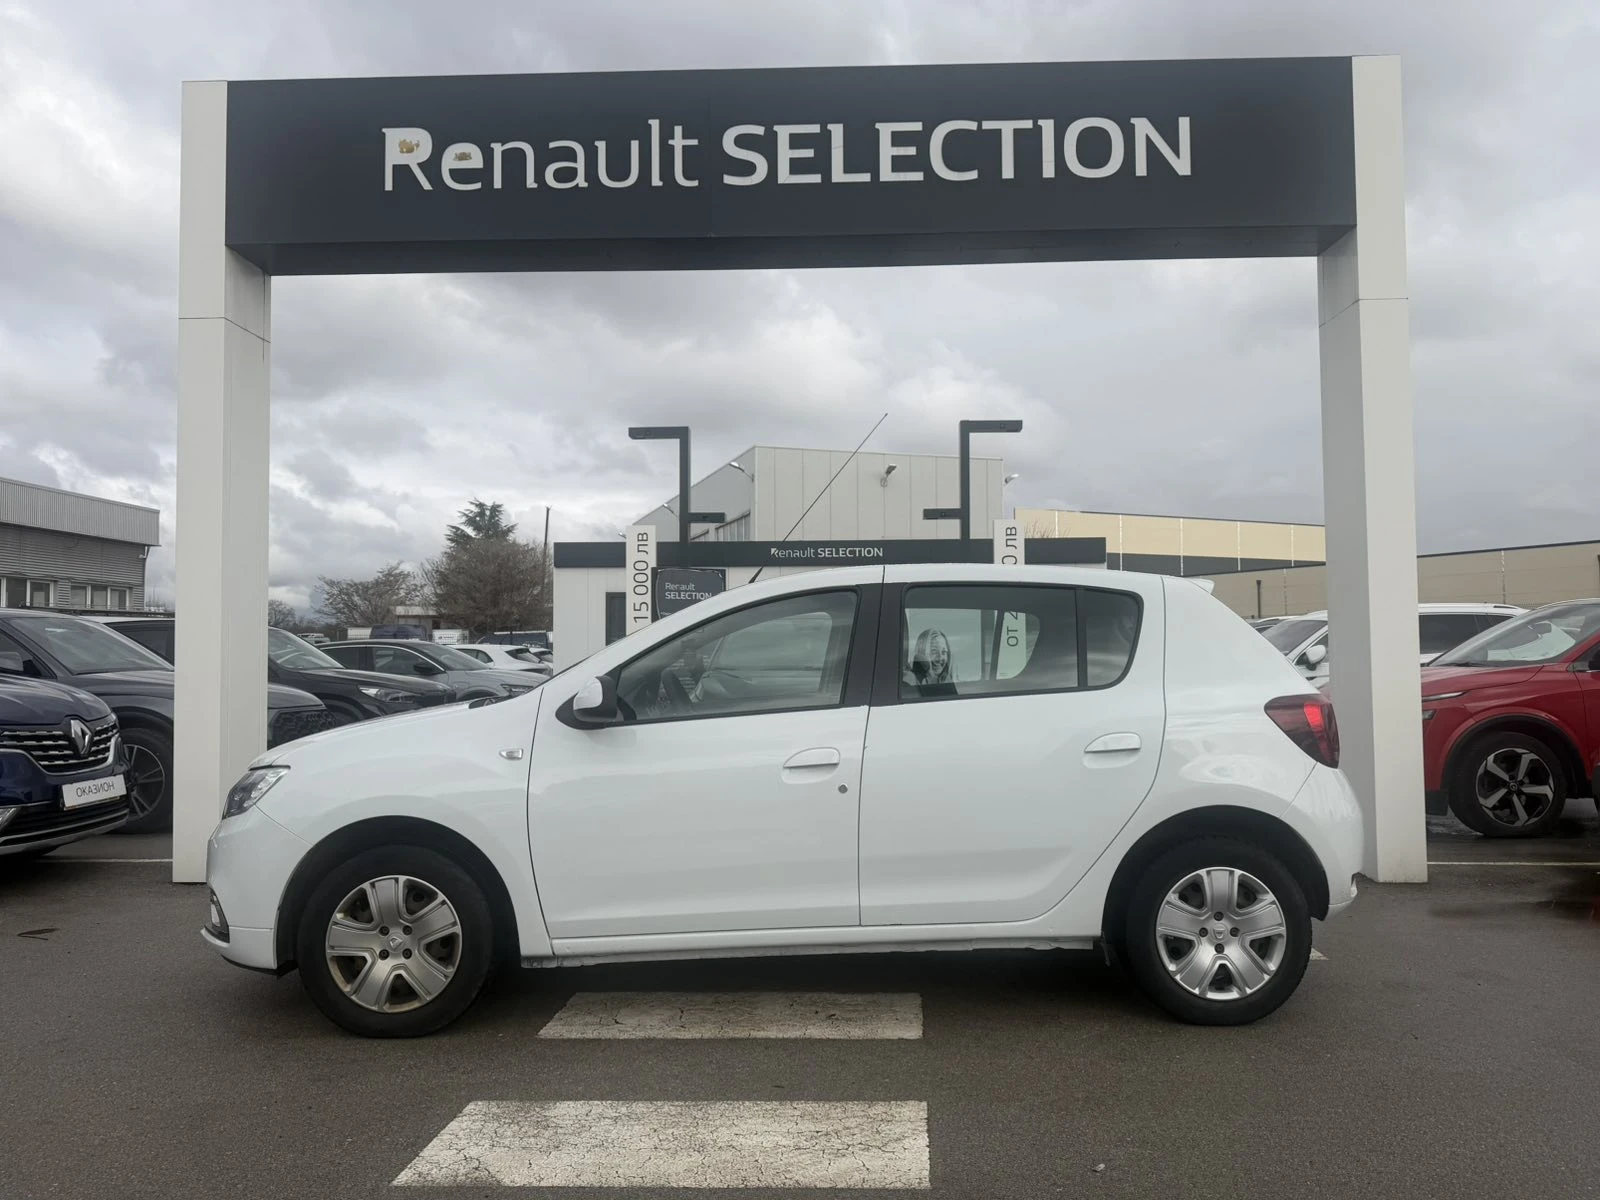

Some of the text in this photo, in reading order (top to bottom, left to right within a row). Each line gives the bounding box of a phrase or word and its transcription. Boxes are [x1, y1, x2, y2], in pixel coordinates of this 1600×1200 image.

[381, 116, 1193, 191] Renault SELECTION
[770, 547, 883, 558] Renault SELECTION
[633, 560, 649, 596] 000
[665, 591, 712, 600] SELECTION
[633, 601, 649, 623] 15
[75, 781, 115, 797] ОКАЗИОН
